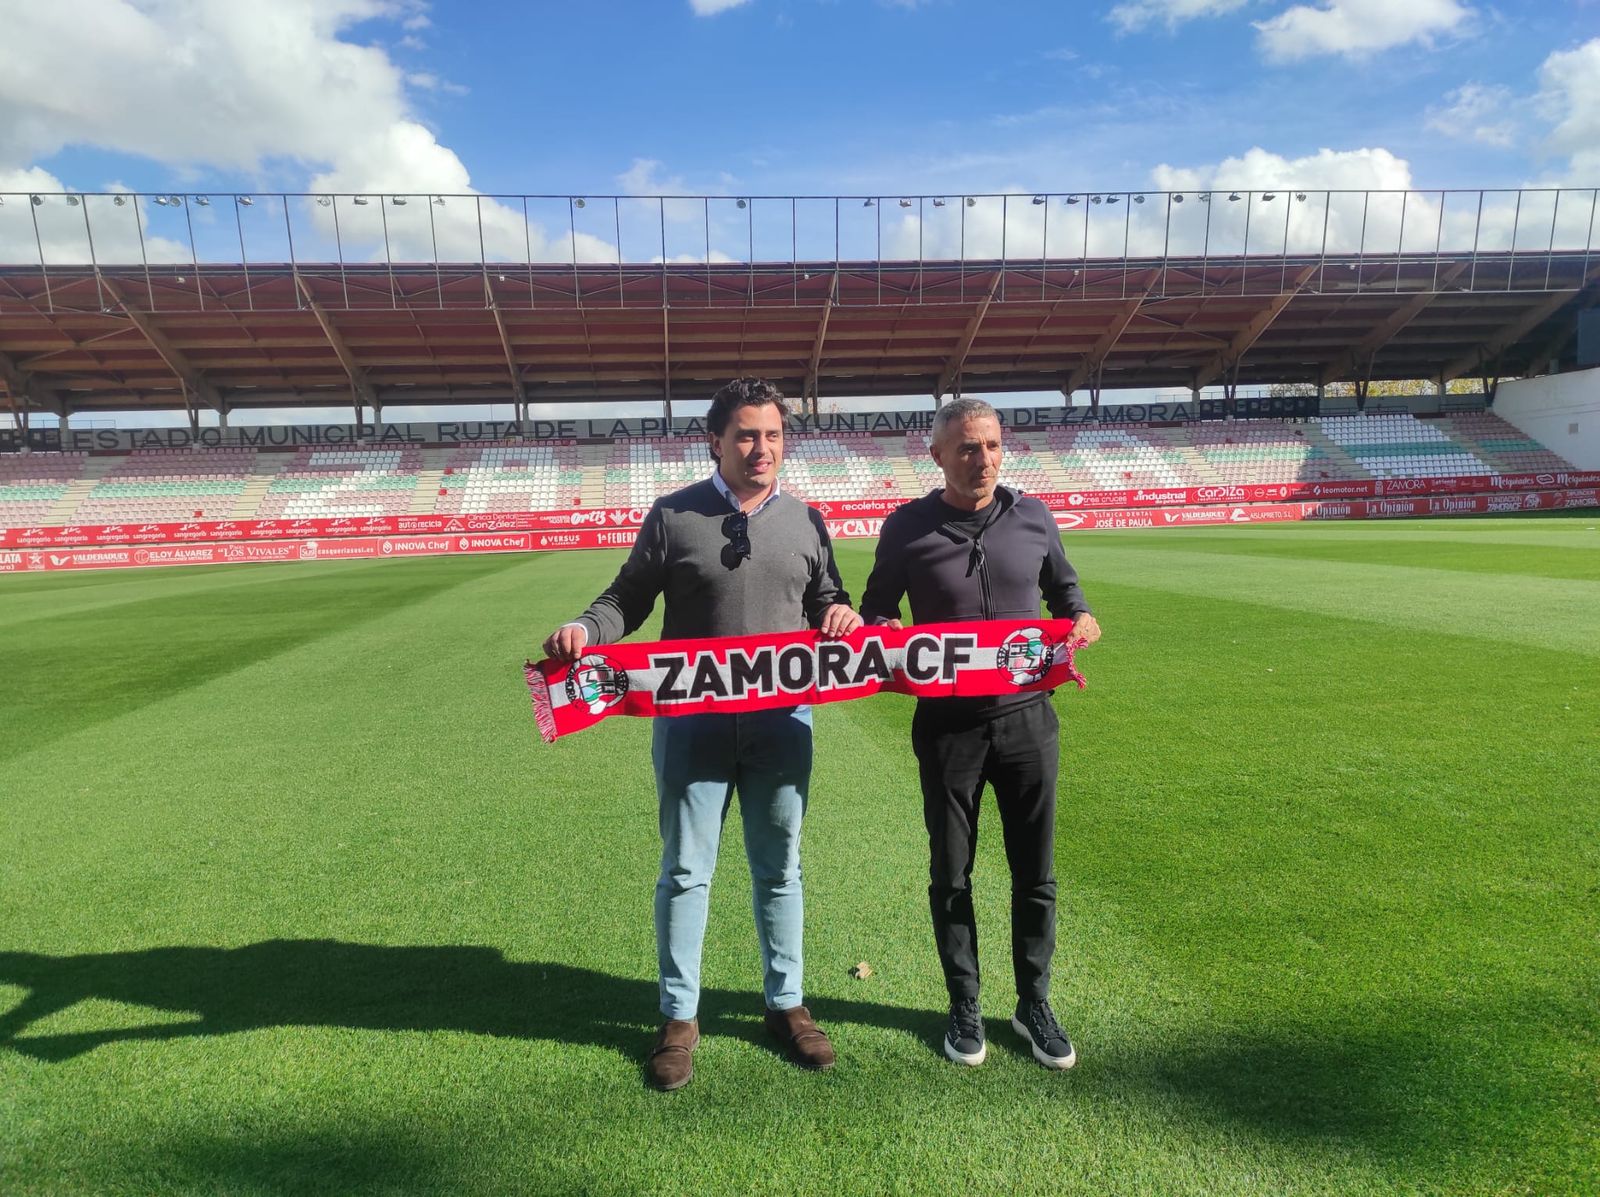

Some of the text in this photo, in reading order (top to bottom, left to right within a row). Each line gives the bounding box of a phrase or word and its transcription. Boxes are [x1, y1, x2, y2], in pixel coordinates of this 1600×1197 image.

[1014, 407, 1051, 426] DE
[1061, 403, 1192, 424] ZAMORA
[74, 428, 221, 449] ESTADO
[437, 421, 522, 442] RUTA
[535, 420, 577, 439] DE
[589, 418, 632, 438] LA
[1322, 485, 1368, 495] leomotor.net
[1386, 479, 1426, 490] ZAMORA
[1116, 518, 1126, 527] DE
[1129, 518, 1153, 527] PAULA
[648, 636, 895, 705] ZAMORA
[904, 633, 977, 684] CF
